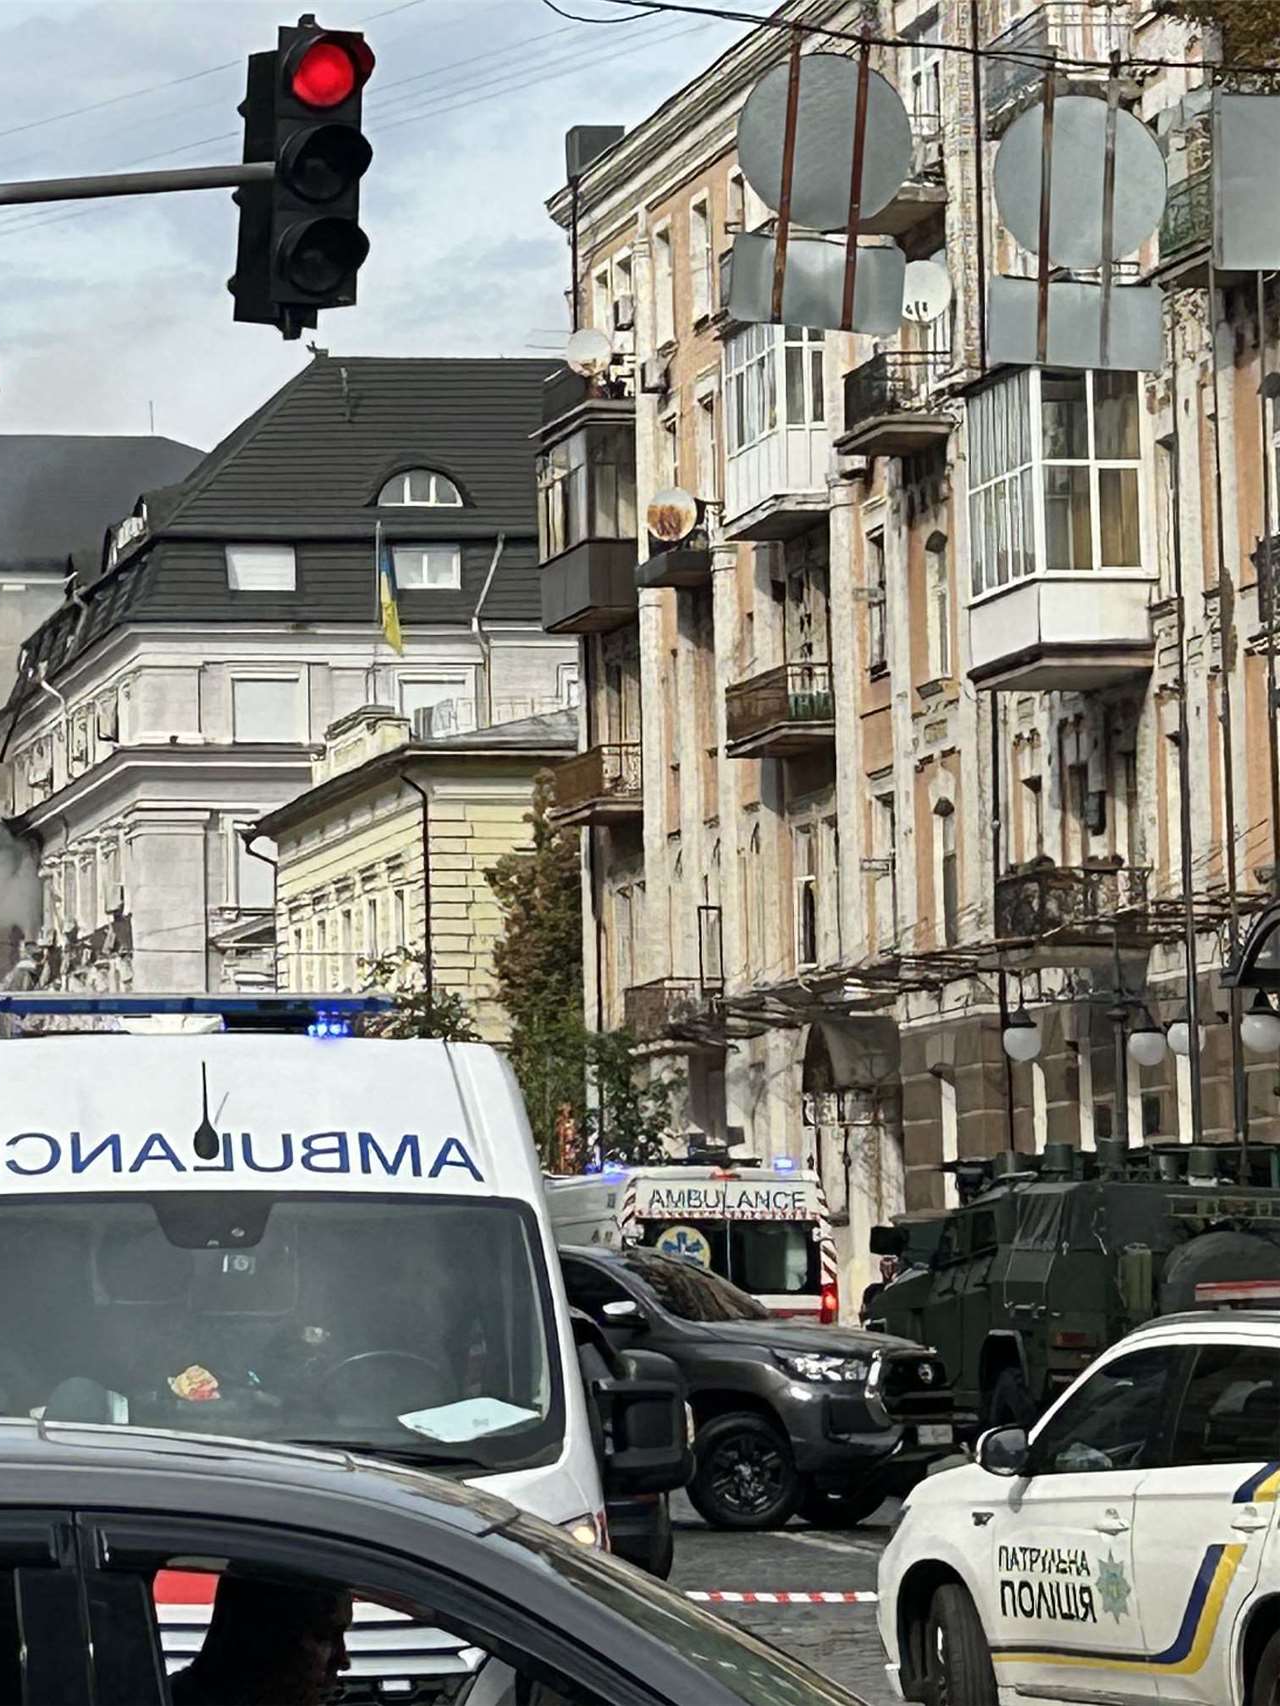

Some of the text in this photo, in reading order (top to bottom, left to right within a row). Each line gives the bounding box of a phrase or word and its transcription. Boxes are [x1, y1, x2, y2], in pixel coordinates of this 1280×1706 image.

[649, 1188, 806, 1213] AMBULANCE
[999, 1545, 1091, 1577] ПАТРУЛЬНА
[1000, 1580, 1098, 1624] ПОЛІЦІЯ
